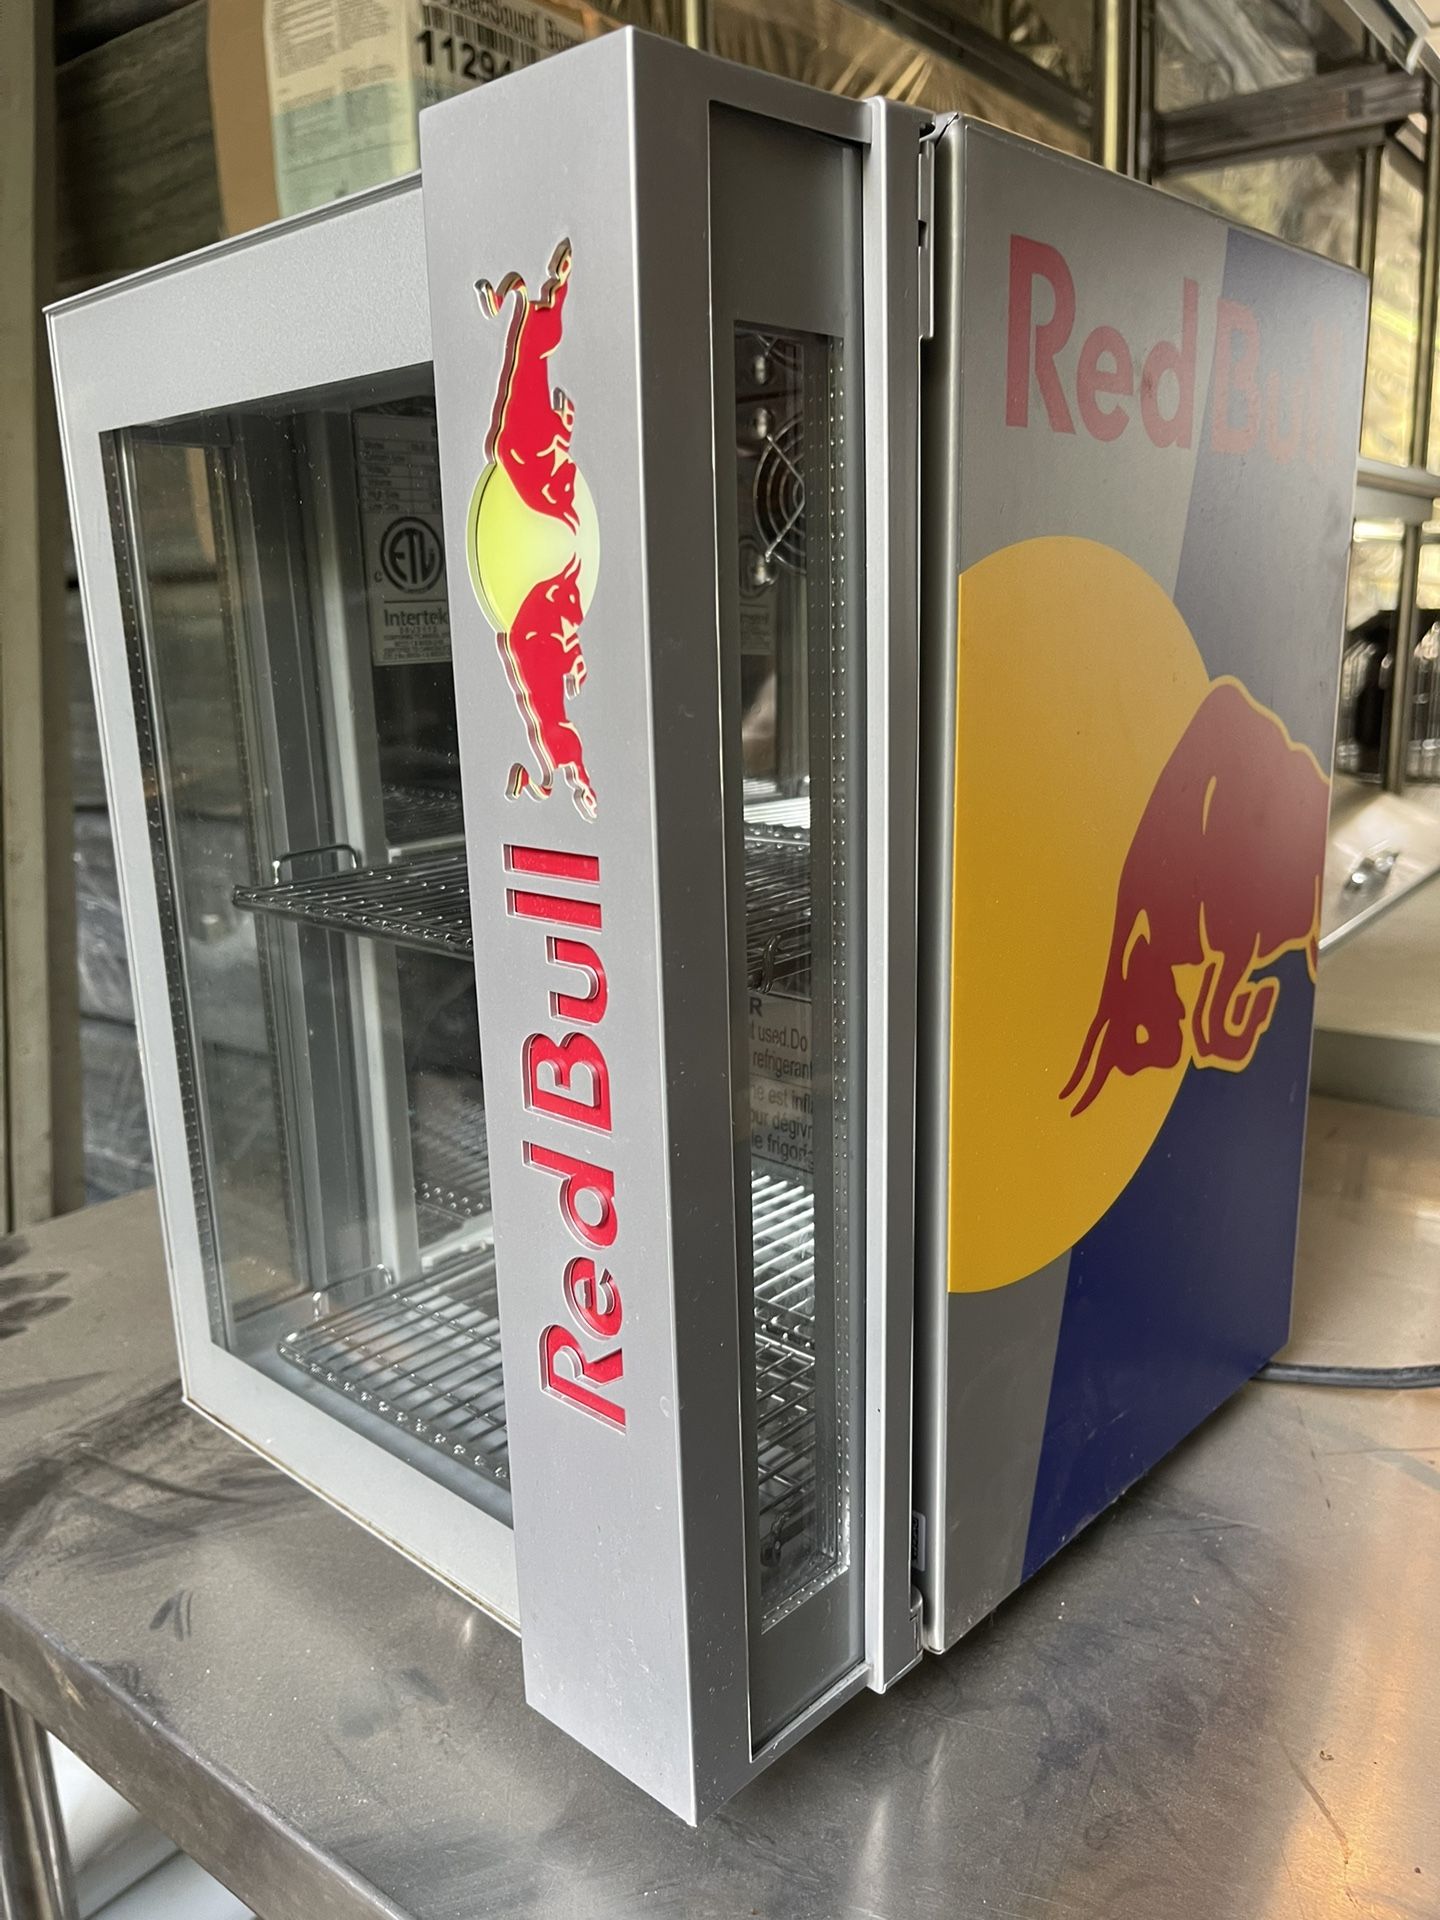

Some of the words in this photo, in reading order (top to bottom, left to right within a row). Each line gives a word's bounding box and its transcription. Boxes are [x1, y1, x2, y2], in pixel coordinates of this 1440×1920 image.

[1005, 233, 1199, 449] Red
[1210, 296, 1345, 468] Bull
[383, 606, 449, 627] Intertek
[501, 842, 612, 1138] Bull
[521, 1140, 627, 1436] Red
